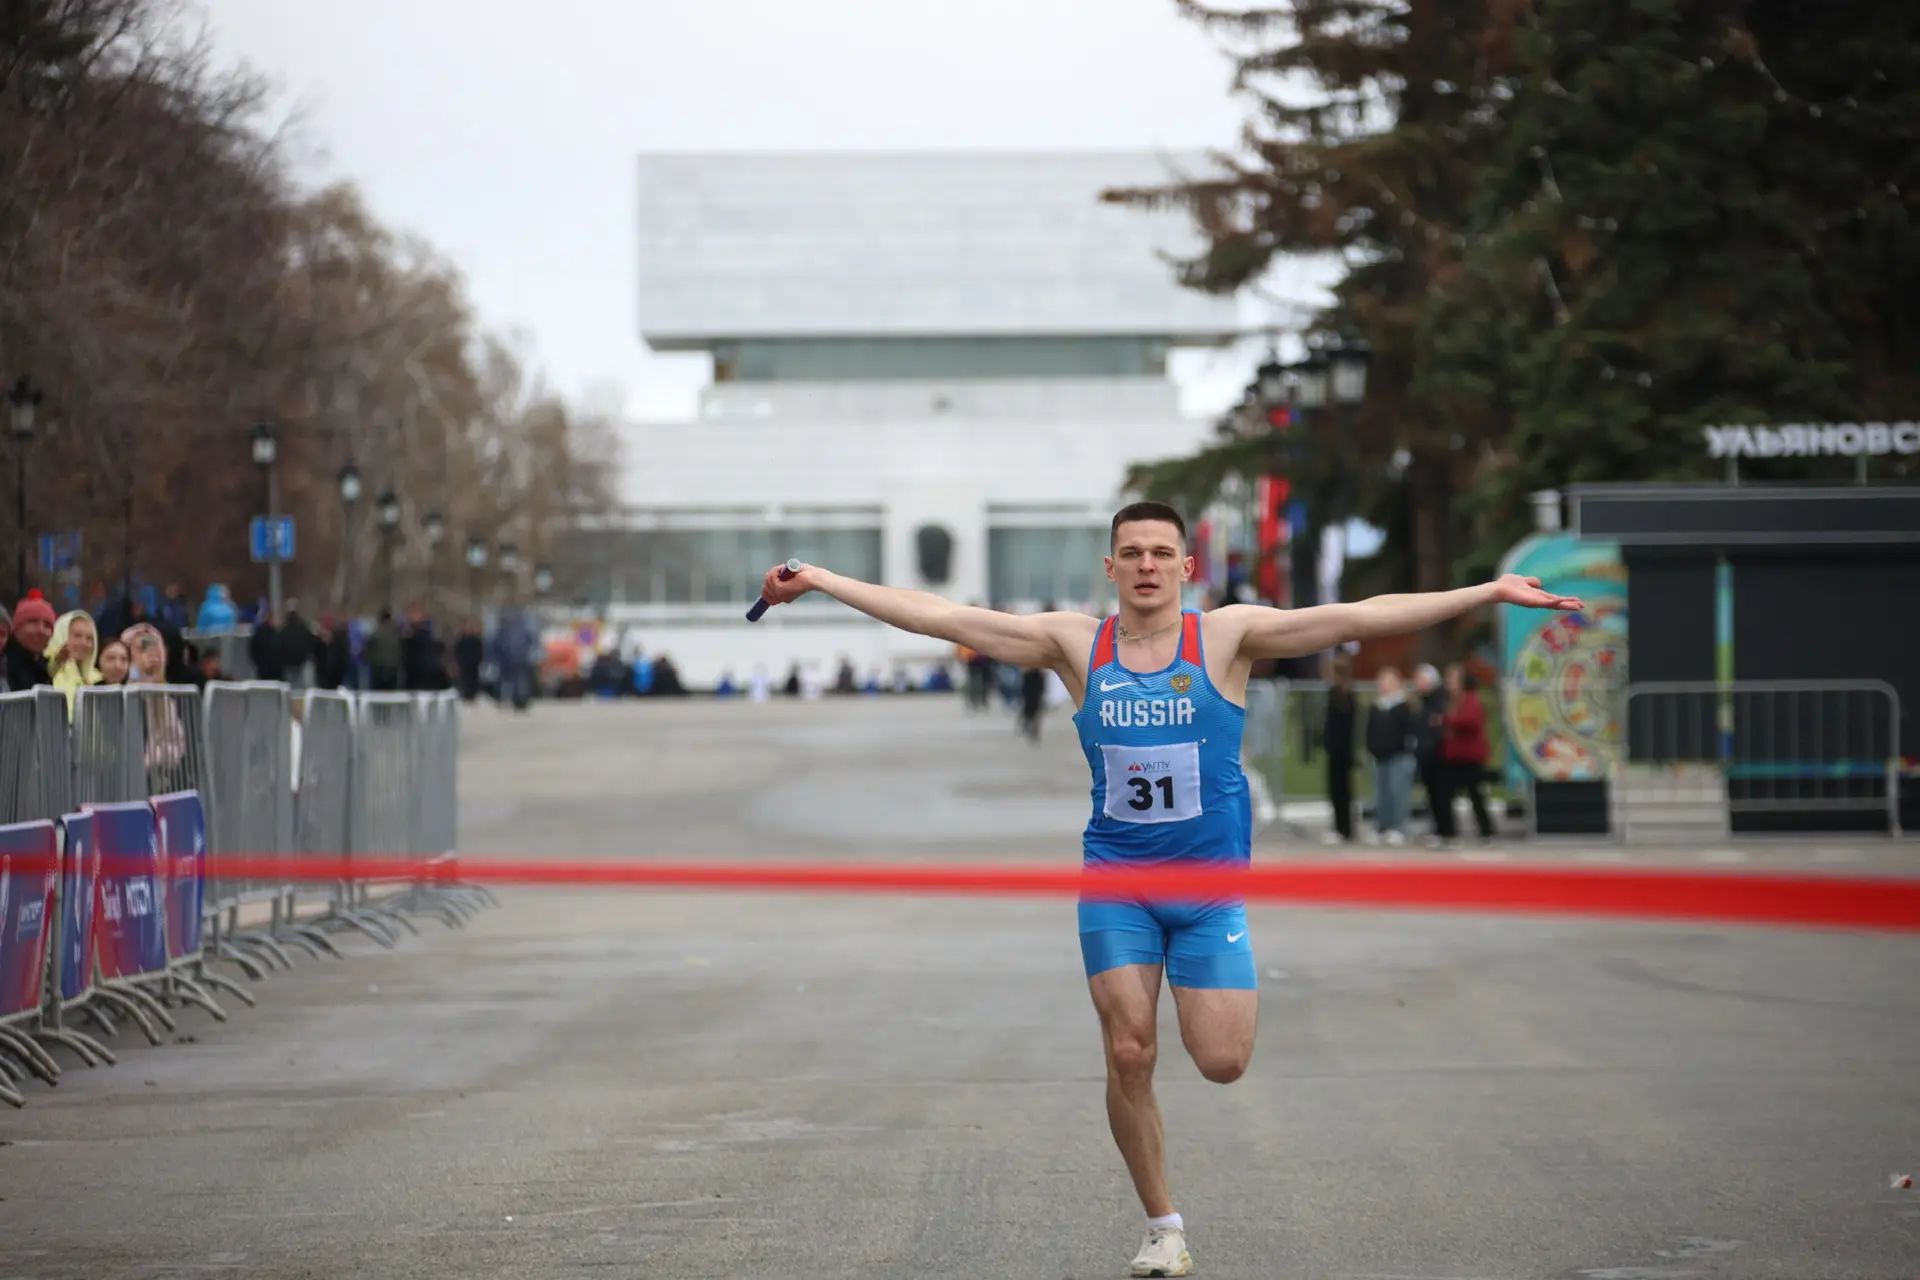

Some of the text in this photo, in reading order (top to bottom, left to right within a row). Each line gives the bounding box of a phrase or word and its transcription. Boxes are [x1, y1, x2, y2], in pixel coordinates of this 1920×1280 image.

[1704, 421, 1920, 458] УЛЬЯНОВС
[1099, 698, 1195, 727] RUSSIA
[1127, 776, 1174, 811] 31
